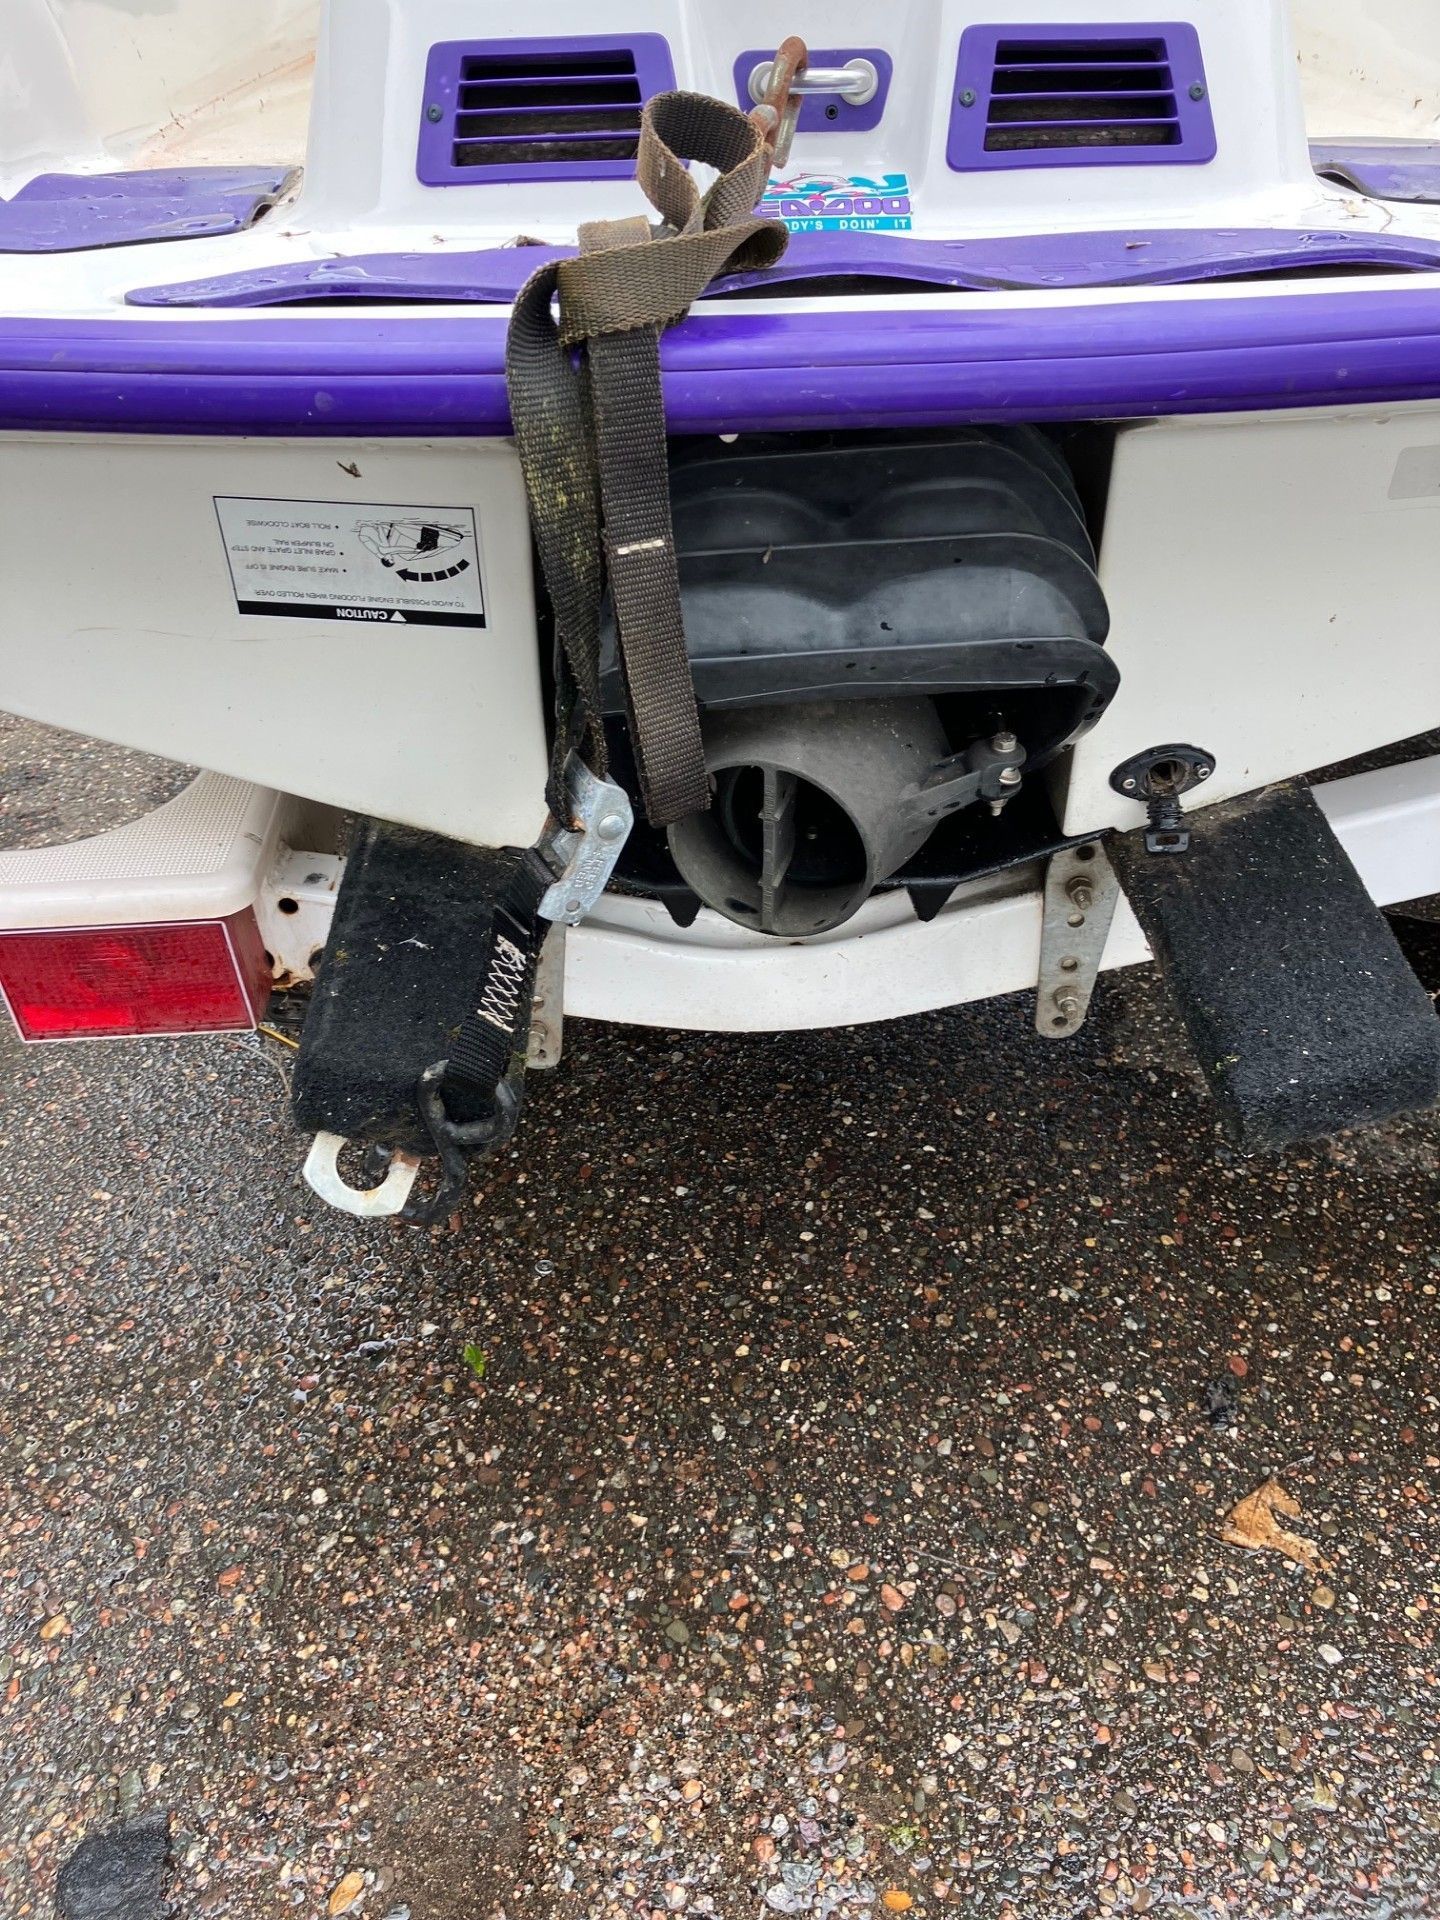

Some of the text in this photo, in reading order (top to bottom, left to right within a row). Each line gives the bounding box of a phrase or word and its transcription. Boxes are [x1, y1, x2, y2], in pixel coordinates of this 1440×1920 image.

[839, 219, 880, 230] DOIN'
[894, 219, 907, 229] IT
[246, 520, 289, 528] CLOCKWISE
[267, 546, 292, 554] GRATE
[329, 594, 366, 602] FLOODING
[367, 596, 394, 604] ENGINE
[396, 598, 430, 606] POSSIBLE
[336, 608, 388, 619] CAUTION
